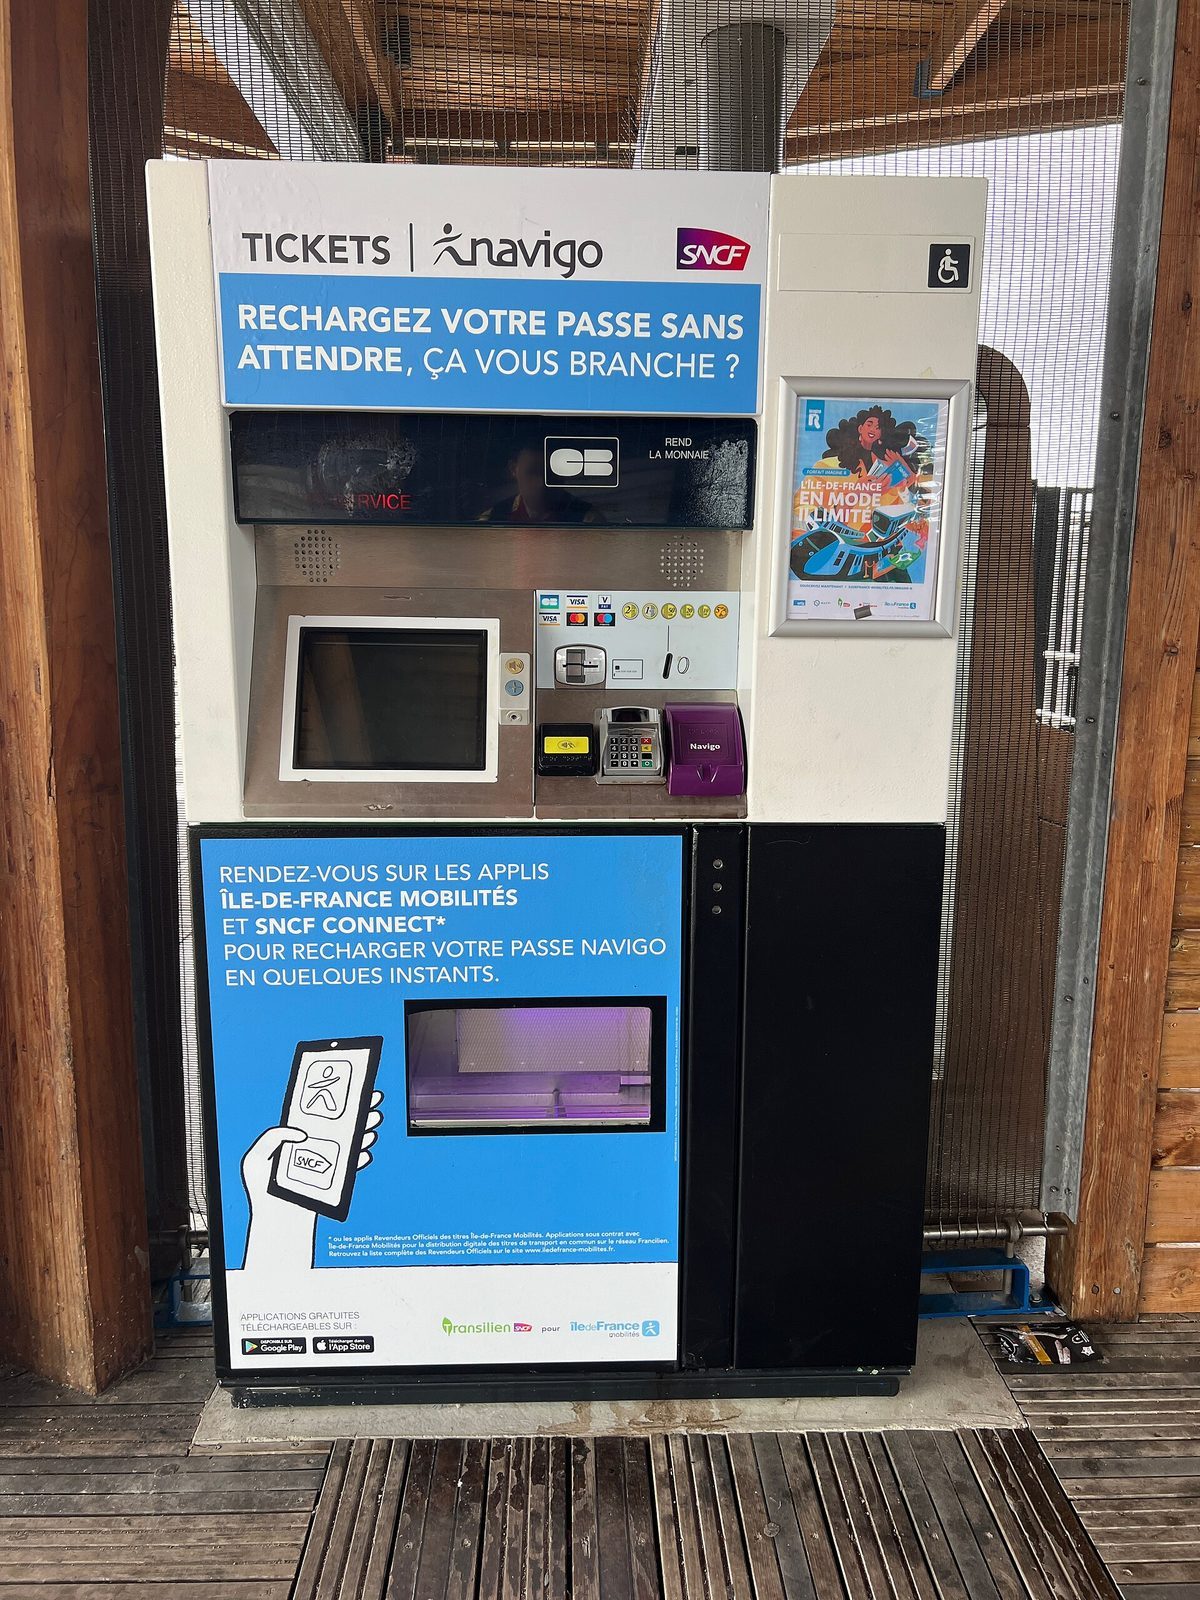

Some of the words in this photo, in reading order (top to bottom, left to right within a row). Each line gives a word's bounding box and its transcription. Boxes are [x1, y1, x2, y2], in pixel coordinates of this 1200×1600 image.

[242, 232, 391, 266] TICKETS
[468, 230, 603, 278] navigo
[680, 244, 746, 265] SNCF
[238, 304, 430, 334] RECHARGEZ
[440, 308, 546, 336] VOTRE
[558, 311, 651, 339] PASSE
[661, 313, 744, 340] SANS
[238, 345, 412, 377] ATTENDRE,
[423, 348, 466, 381] ÇA
[475, 349, 558, 377] VOUS
[571, 351, 715, 378] BRANCHE
[726, 354, 740, 379] ?
[665, 437, 692, 447] REND
[649, 450, 661, 459] LA
[665, 450, 709, 460] MONNAIE
[801, 479, 882, 491] L'ÎLE-DE-FRANCE
[800, 491, 824, 505] EN
[828, 492, 882, 507] MODE
[690, 742, 721, 751] Navigo
[220, 864, 379, 884] RENDEZ-VOUS
[386, 864, 428, 882] SUR
[435, 863, 471, 881] LES
[478, 863, 550, 881] APPLIS
[220, 889, 393, 910] ÎLE-DE-FRANCE
[400, 884, 518, 907] MOBILITÉS
[223, 918, 248, 935] ET
[255, 917, 315, 935] SNCF
[225, 944, 285, 961] POUR
[293, 941, 426, 959] RECHARGER
[431, 940, 504, 958] VOTRE
[511, 939, 574, 957] PASSE
[581, 937, 667, 956] NAVIGO
[226, 969, 256, 986] EN
[262, 967, 383, 987] QUELQUES
[390, 966, 499, 984] INSTANTS.
[296, 1155, 324, 1169] SNCF
[463, 1240, 487, 1248] digitale
[528, 1239, 558, 1247] transport
[240, 1312, 307, 1321] APPLICATIONS
[308, 1311, 360, 1320] GRATUITES
[241, 1322, 331, 1332] TÉLÉCHARGEABLES
[333, 1322, 352, 1330] SUR
[443, 1318, 511, 1336] Transilien
[541, 1325, 560, 1334] pour
[260, 1345, 288, 1353] Google
[288, 1344, 303, 1353] Play
[329, 1343, 349, 1352] l'App
[350, 1343, 371, 1351] Store
